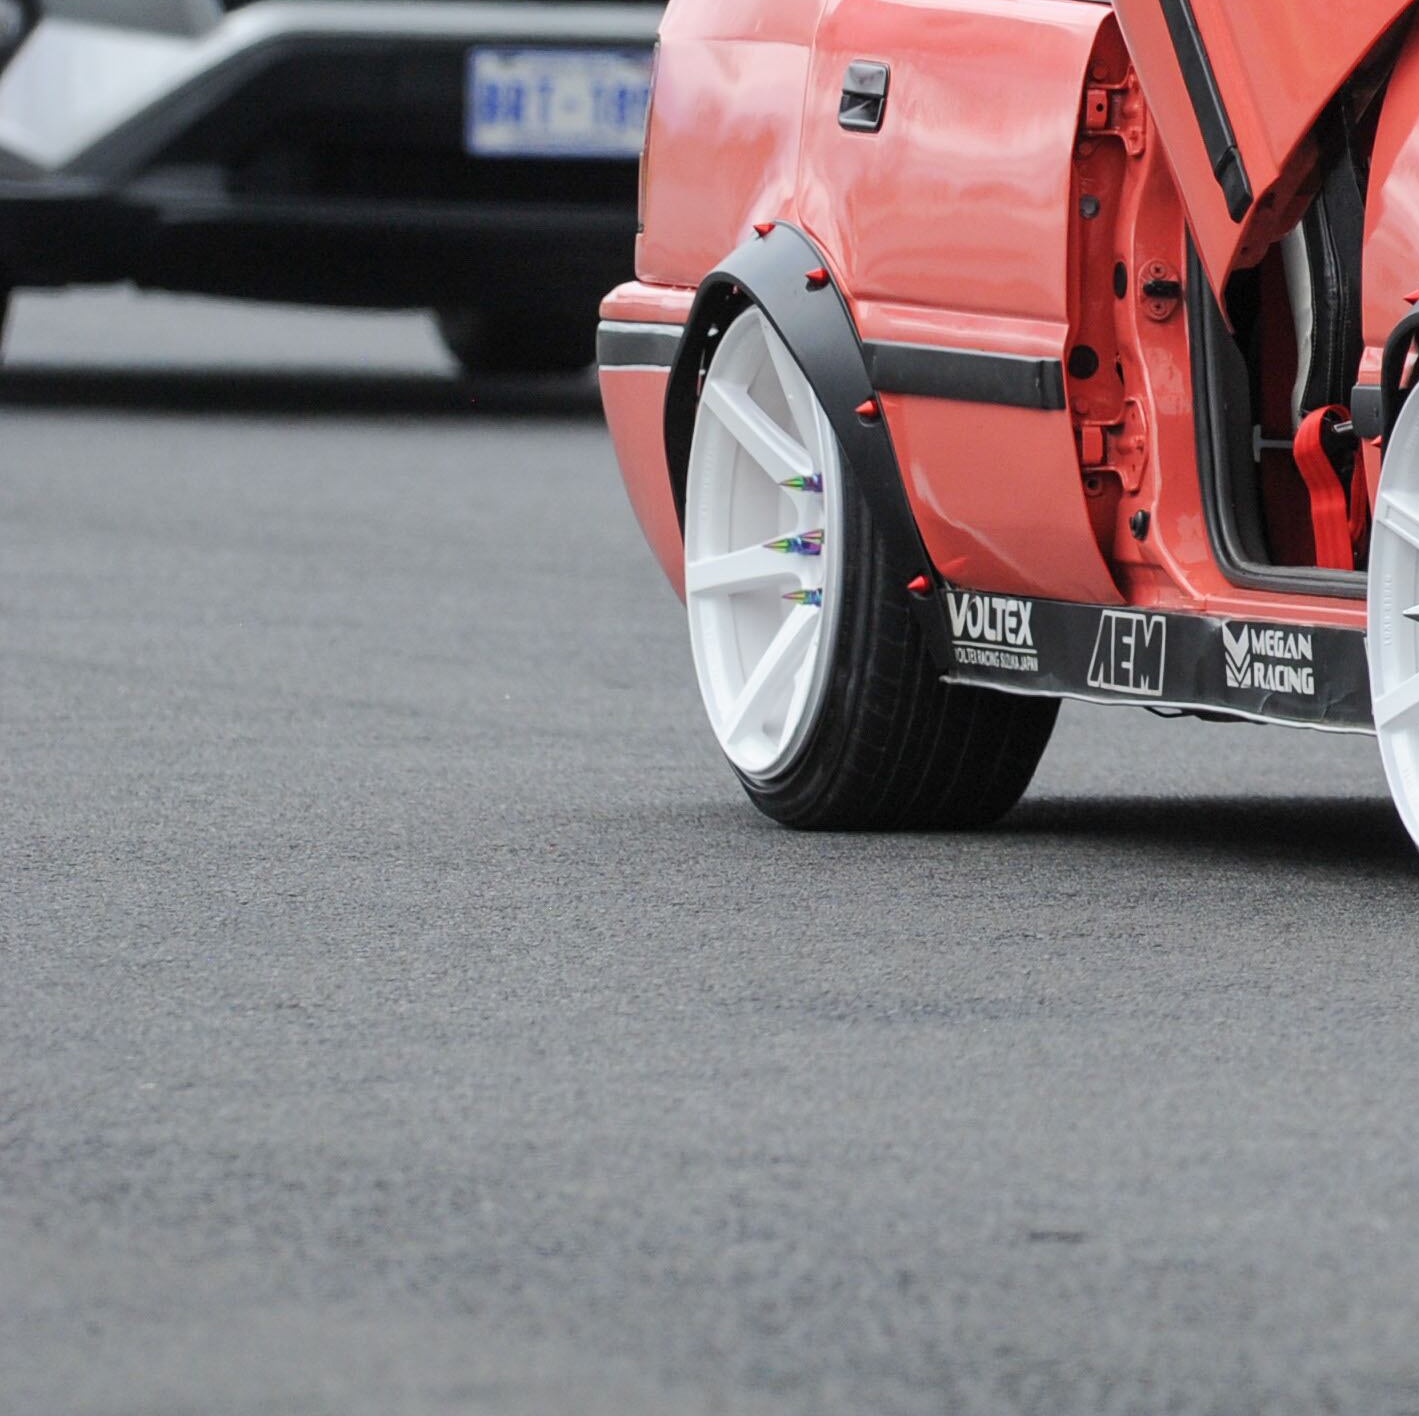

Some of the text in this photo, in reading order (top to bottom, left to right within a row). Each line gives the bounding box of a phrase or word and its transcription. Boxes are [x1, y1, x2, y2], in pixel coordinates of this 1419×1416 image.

[946, 592, 1034, 647] VOLTEX
[1087, 609, 1167, 696] AEM
[1250, 628, 1313, 661] MEGAN
[1252, 661, 1315, 695] RACING
